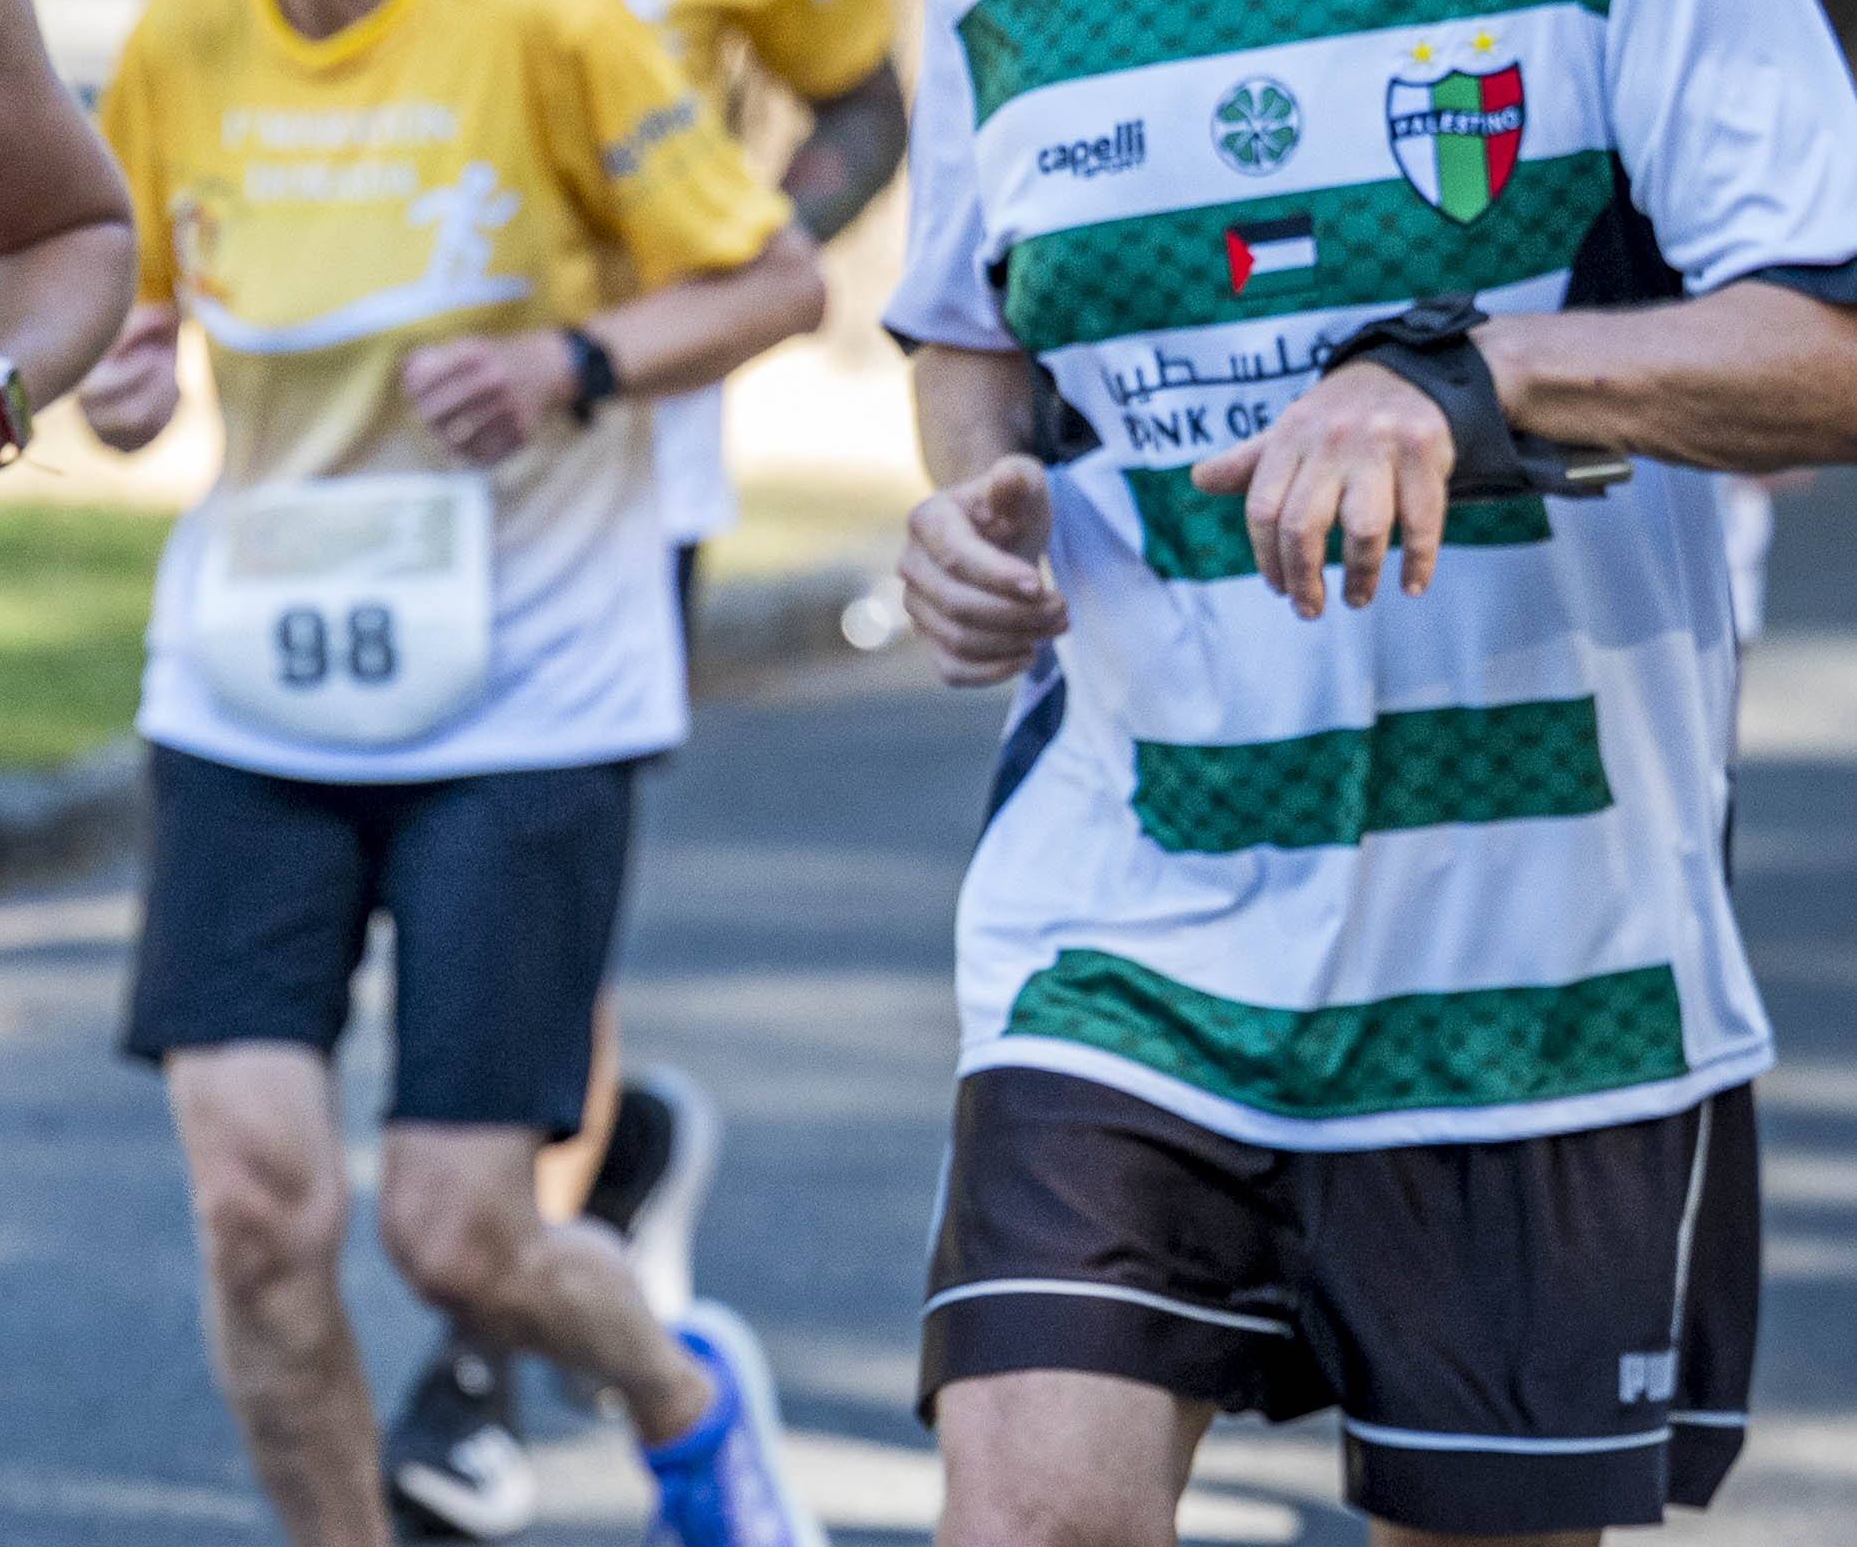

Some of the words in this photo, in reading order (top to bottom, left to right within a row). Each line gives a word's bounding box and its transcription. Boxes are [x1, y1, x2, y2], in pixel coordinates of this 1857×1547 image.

[1037, 117, 1146, 176] capelli
[276, 605, 397, 688] 98
[1618, 1351, 1676, 1403] PU
